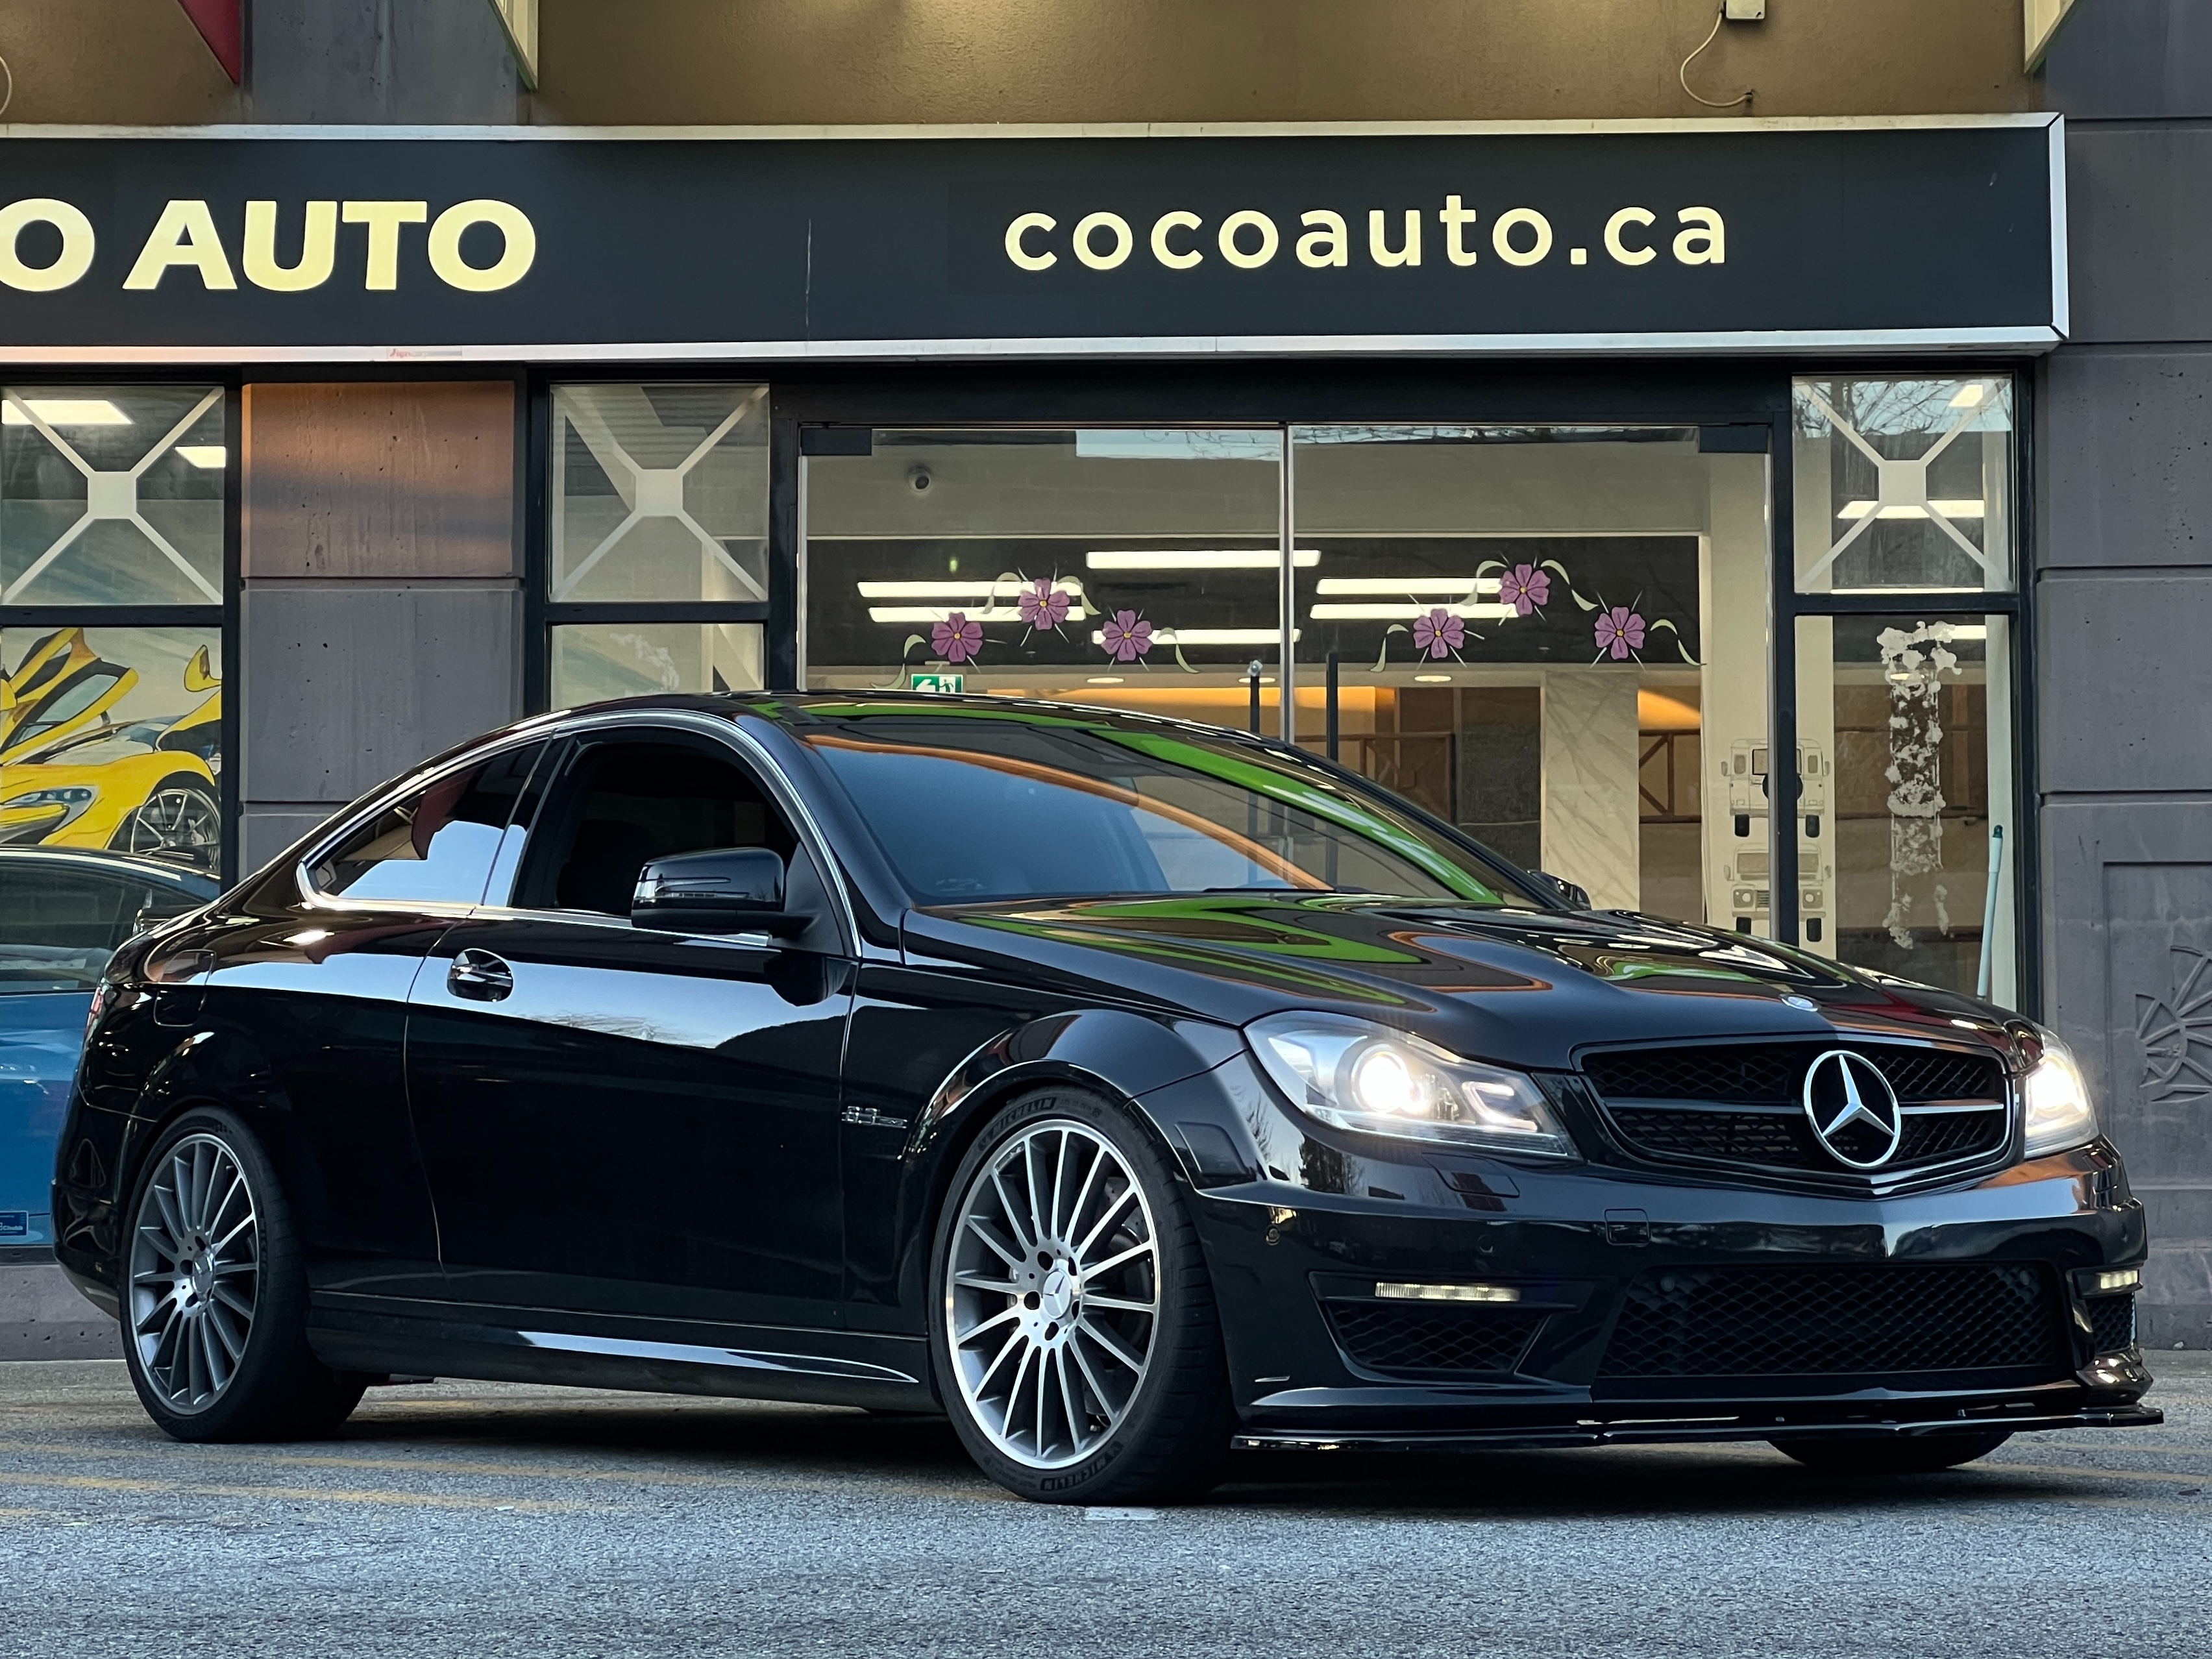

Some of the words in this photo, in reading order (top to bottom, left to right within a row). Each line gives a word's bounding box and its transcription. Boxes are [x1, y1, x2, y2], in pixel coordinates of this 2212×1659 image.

[123, 199, 535, 291] AUTO
[1005, 195, 1725, 270] cocoauto.ca
[1043, 1456, 1107, 1490] MICHELIN
